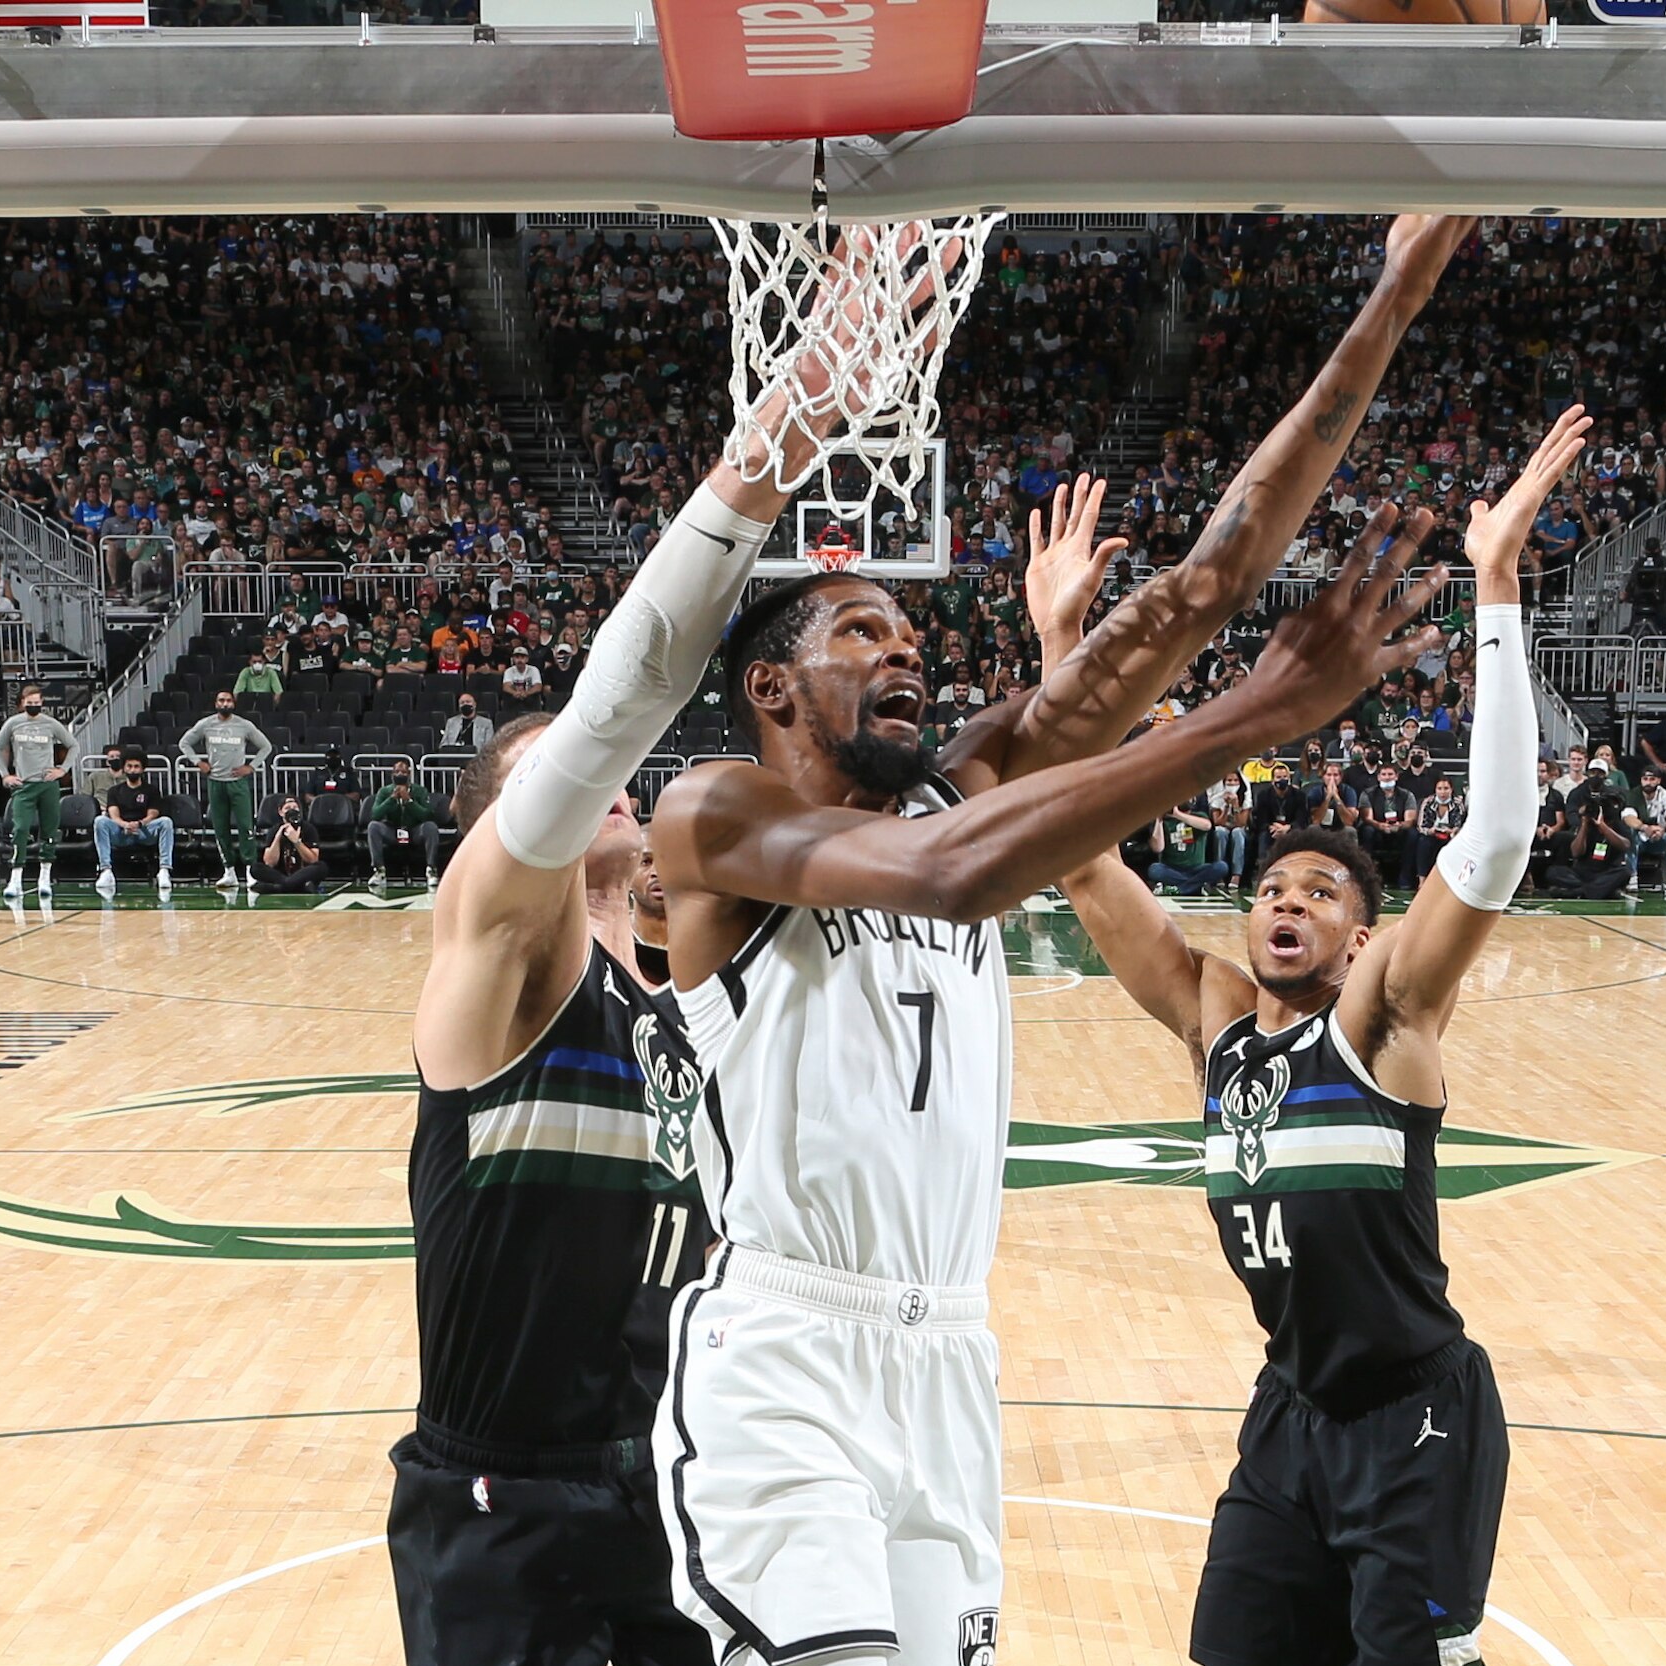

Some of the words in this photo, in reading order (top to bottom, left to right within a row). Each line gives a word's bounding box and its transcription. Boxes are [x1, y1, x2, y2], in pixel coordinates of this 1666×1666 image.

[736, 0, 917, 76] arm
[898, 991, 935, 1112] 7
[642, 1202, 689, 1288] 11
[1232, 1200, 1293, 1269] 34
[963, 1612, 999, 1650] NET
